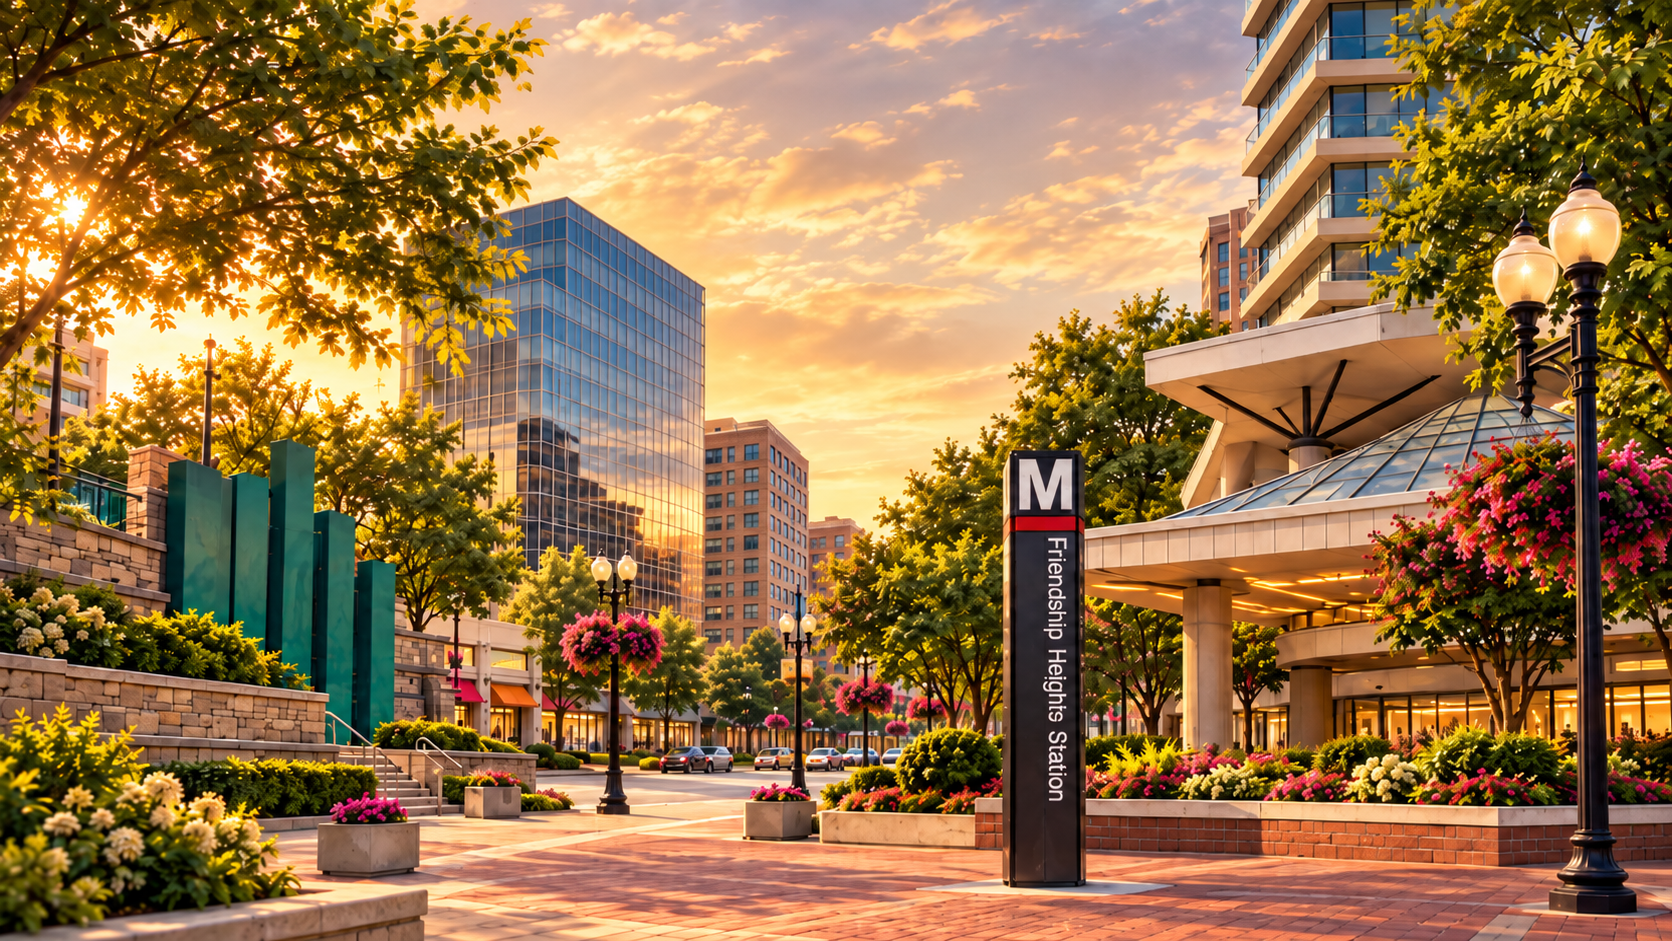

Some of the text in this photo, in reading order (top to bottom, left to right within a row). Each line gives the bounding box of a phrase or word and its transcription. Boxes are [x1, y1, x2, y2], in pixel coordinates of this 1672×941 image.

[1018, 458, 1073, 511] M
[1043, 537, 1068, 802] Friendship Heights Station
